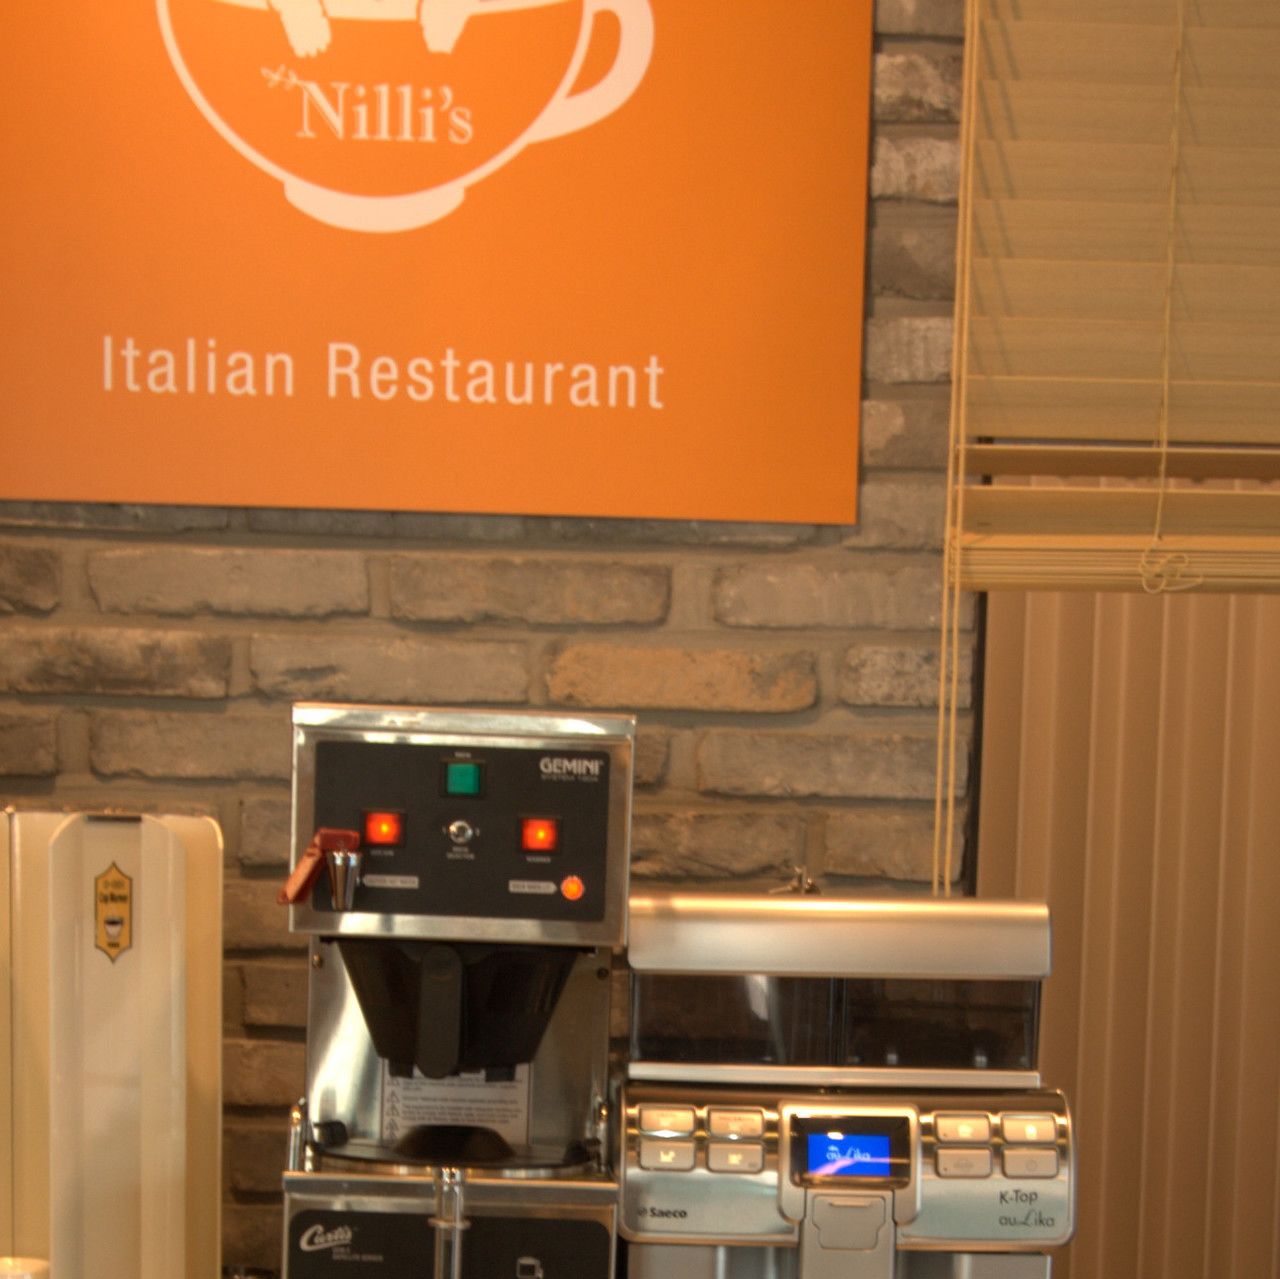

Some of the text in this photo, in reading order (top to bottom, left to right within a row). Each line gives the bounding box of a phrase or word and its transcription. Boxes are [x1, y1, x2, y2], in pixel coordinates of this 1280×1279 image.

[296, 80, 474, 145] Nilli's
[102, 335, 666, 409] Italian Restaurant
[539, 756, 600, 776] GEMINI
[999, 1189, 1039, 1206] K-Top
[650, 1206, 688, 1219] Saeco
[299, 1224, 354, 1252] Curtis
